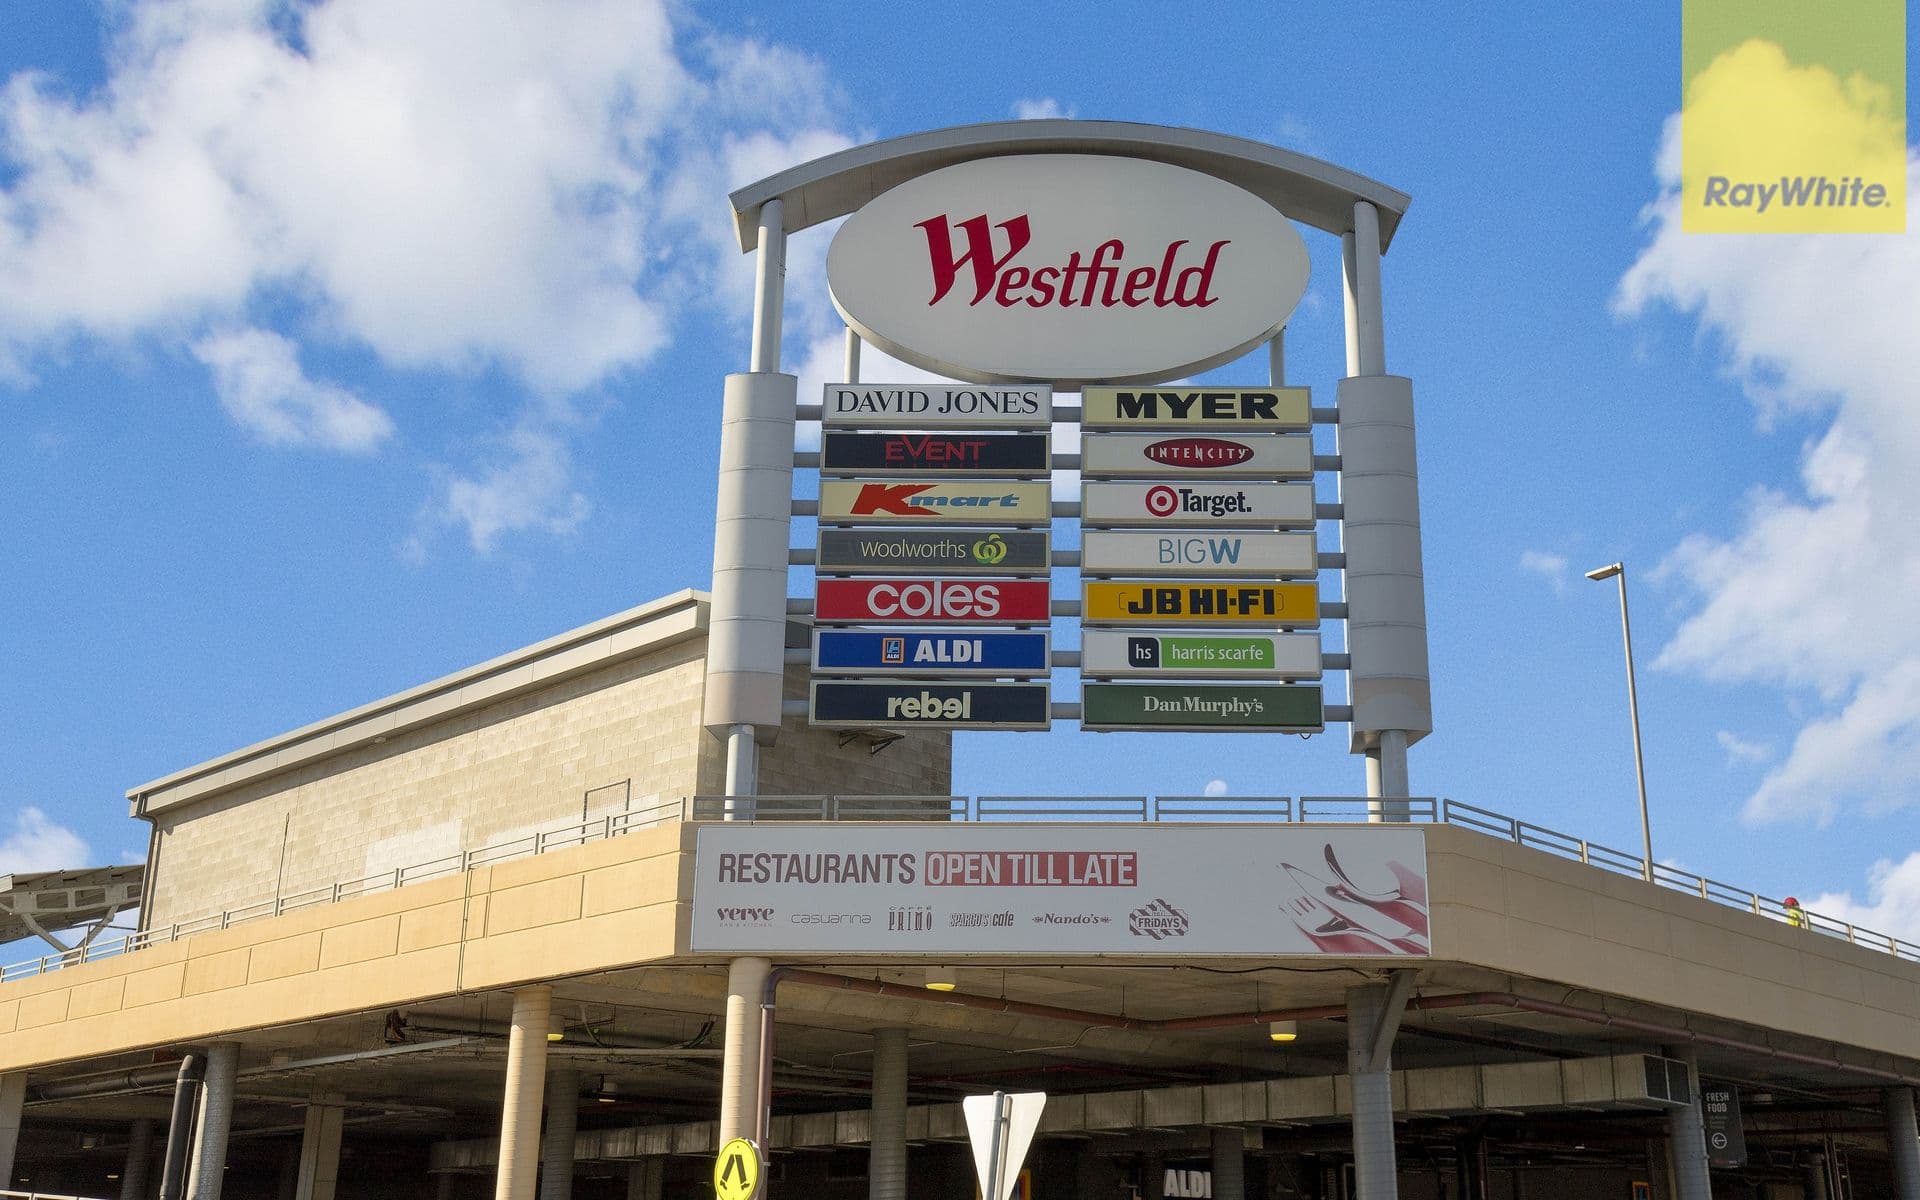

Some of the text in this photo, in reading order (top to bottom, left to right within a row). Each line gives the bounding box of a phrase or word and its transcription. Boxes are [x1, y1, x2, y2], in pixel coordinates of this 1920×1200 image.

[913, 213, 1232, 308] Westfield
[836, 390, 1039, 415] DAVID JONES
[1116, 392, 1280, 420] MYER
[885, 434, 988, 461] EVENT
[1150, 444, 1246, 462] INTENCITY
[850, 483, 1020, 515] Kmart
[860, 539, 966, 559] Woolworths
[867, 580, 1000, 617] coles
[1128, 588, 1275, 615] JB HI-FI
[913, 639, 982, 662] ALDI
[1135, 644, 1152, 660] hs
[1172, 644, 1264, 661] harris scarfe
[887, 692, 971, 719] rebel
[1143, 695, 1264, 717] Dan Murphy's
[718, 853, 1134, 884] RESTAURANTS OPEN TILL LATE
[716, 908, 775, 921] verve
[791, 913, 872, 924] casuarina
[888, 911, 933, 931] PRIMO
[1044, 913, 1099, 924] Nando's
[1706, 1092, 1729, 1101] FRESH
[1707, 1103, 1727, 1112] FOOD
[1163, 1169, 1212, 1199] ALDI
